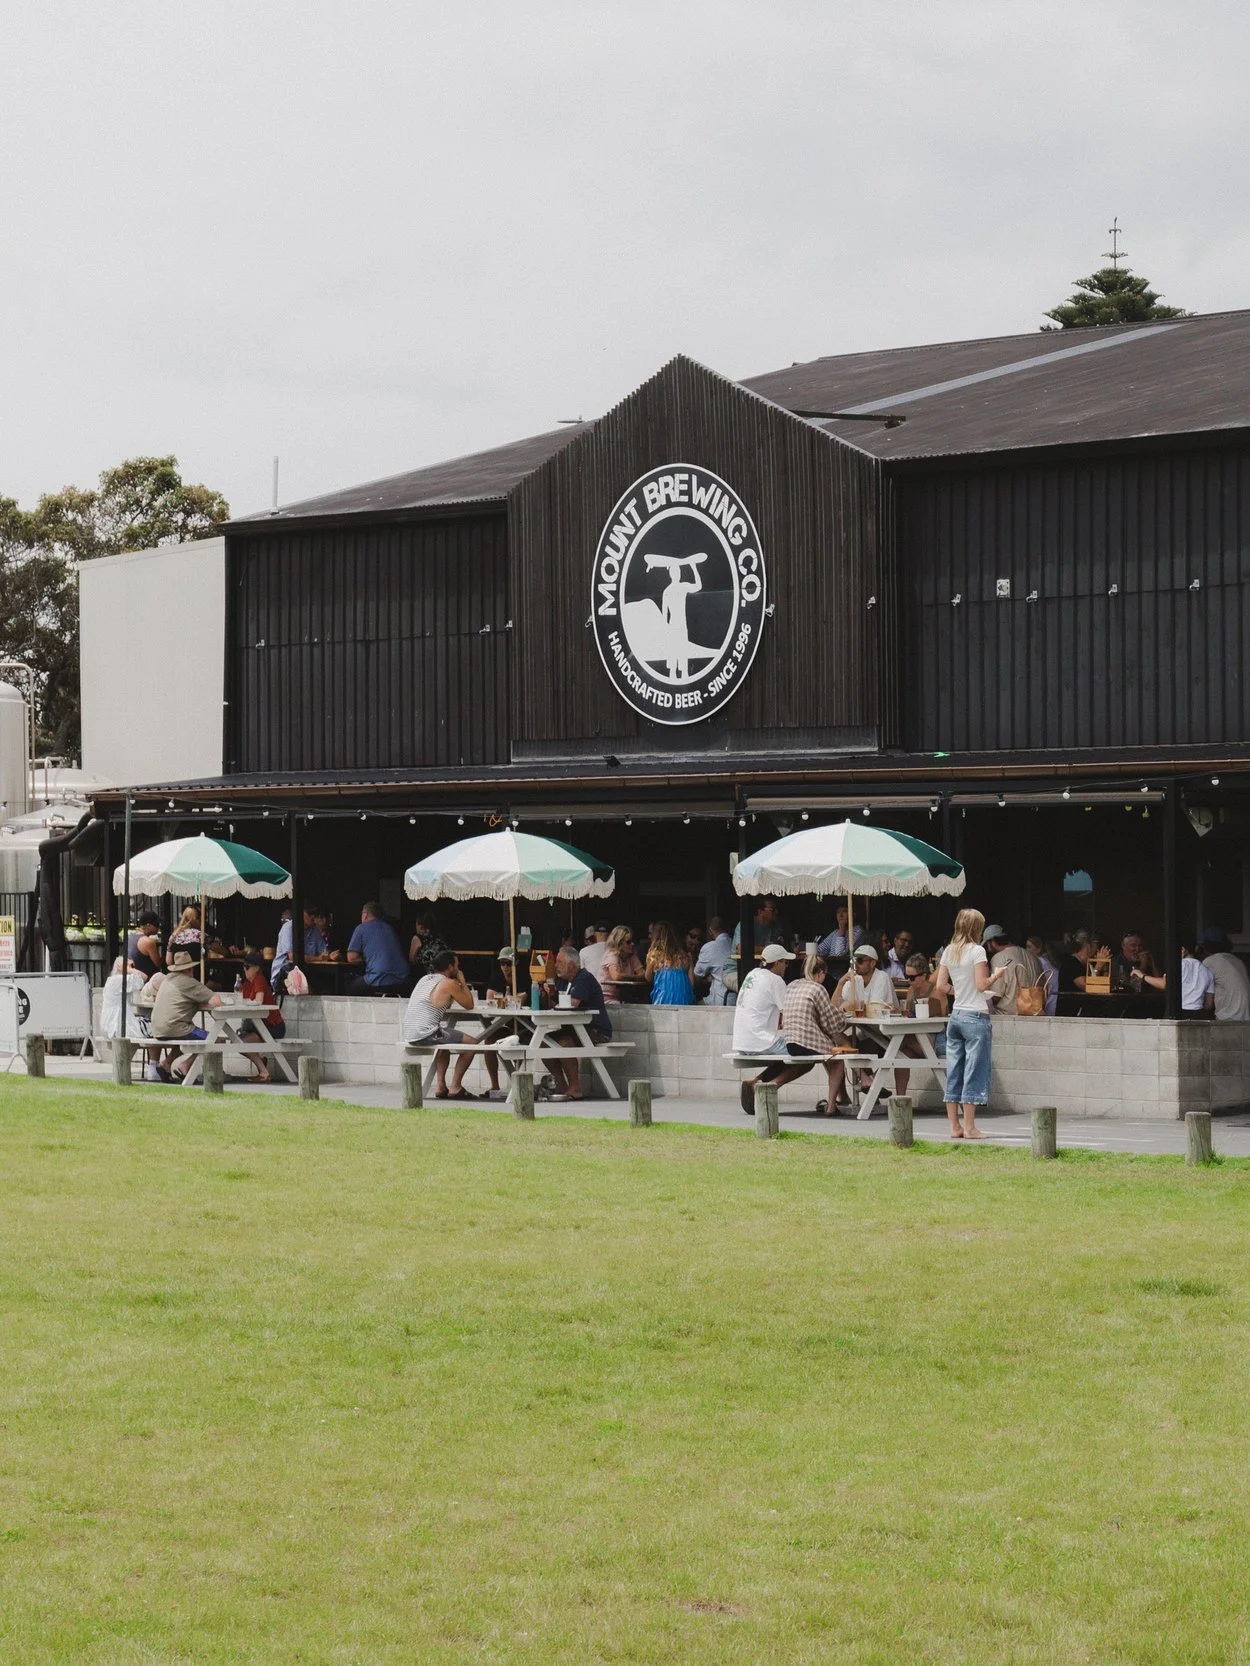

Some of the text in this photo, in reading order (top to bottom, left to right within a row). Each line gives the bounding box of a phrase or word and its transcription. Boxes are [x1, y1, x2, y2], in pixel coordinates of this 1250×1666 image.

[597, 473, 762, 616] MOUNT BREWING CO.
[607, 631, 672, 708] HANDCRAFTED
[674, 691, 703, 709] BEER
[707, 661, 738, 698] SINCE
[732, 622, 752, 664] 1996
